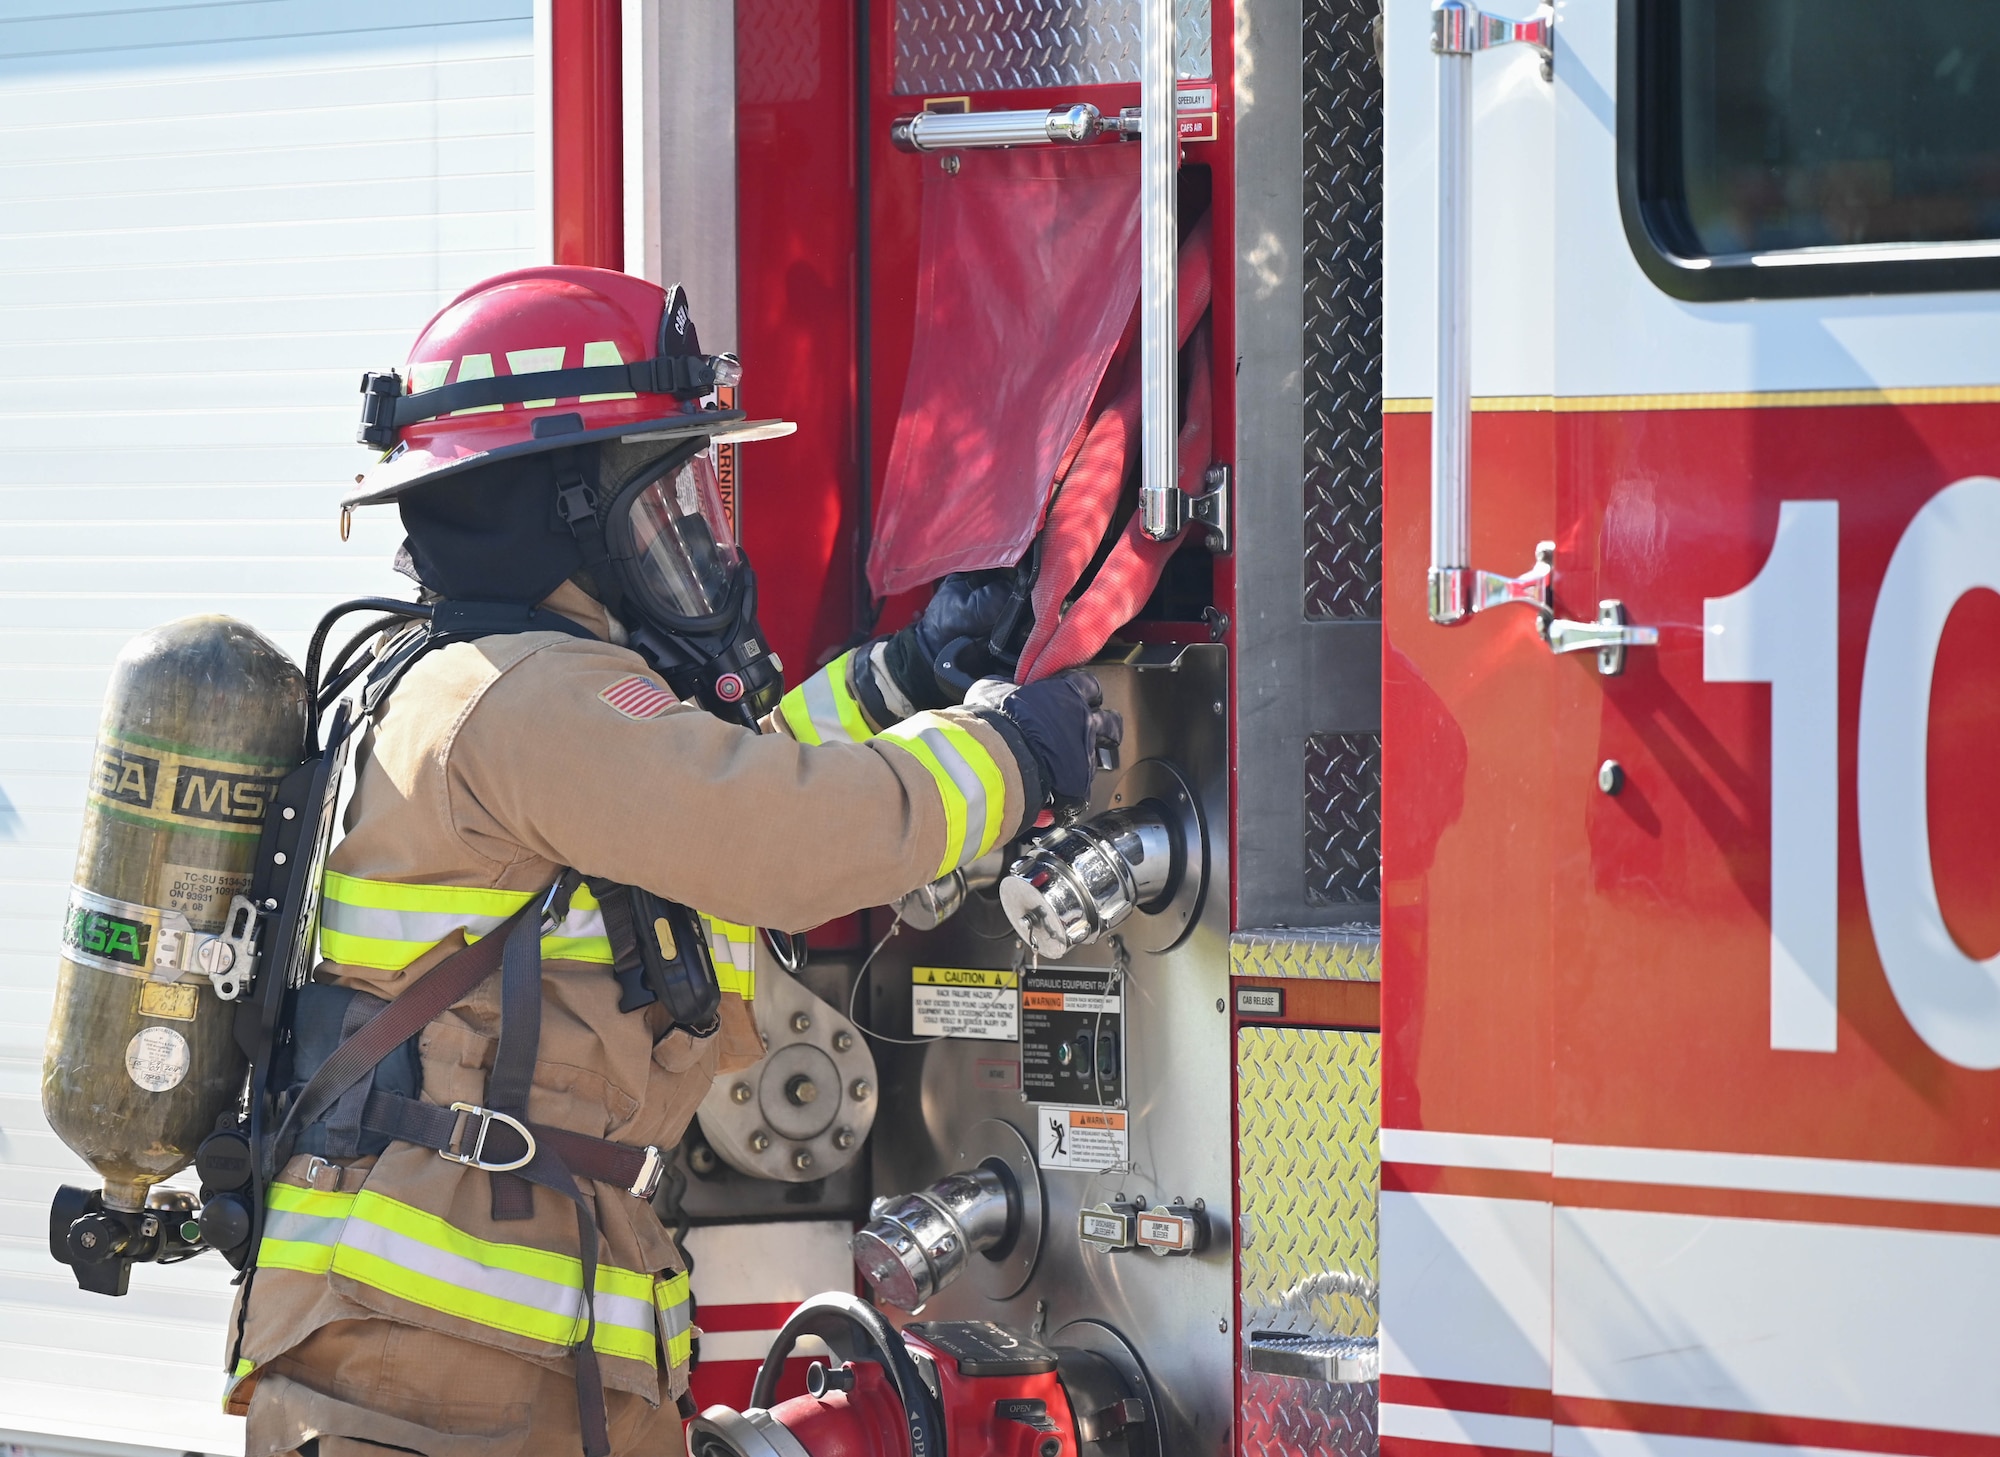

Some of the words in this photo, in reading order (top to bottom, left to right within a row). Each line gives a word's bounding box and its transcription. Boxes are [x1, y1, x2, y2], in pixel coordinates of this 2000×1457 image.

[1178, 96, 1201, 105] SPEEDLAY
[1180, 123, 1193, 133] CAFS
[1194, 122, 1203, 132] AIR
[720, 443, 732, 521] ARNING
[98, 754, 147, 801] SA
[1704, 475, 2000, 1071] 10
[184, 872, 216, 884] TC-SU
[218, 876, 254, 887] 5134-31
[174, 881, 212, 893] DOT-SP
[169, 889, 184, 899] ON
[186, 892, 212, 902] 93931
[944, 971, 985, 984] CAUTION
[1027, 979, 1062, 989] HYDRAULIC
[1062, 980, 1096, 990] EQUIPMENT
[1030, 997, 1061, 1007] WARNING
[1242, 996, 1252, 1005] CAB
[1253, 997, 1274, 1006] RELEASE
[1086, 1116, 1114, 1126] WARNNG
[1009, 1404, 1031, 1414] OPEN
